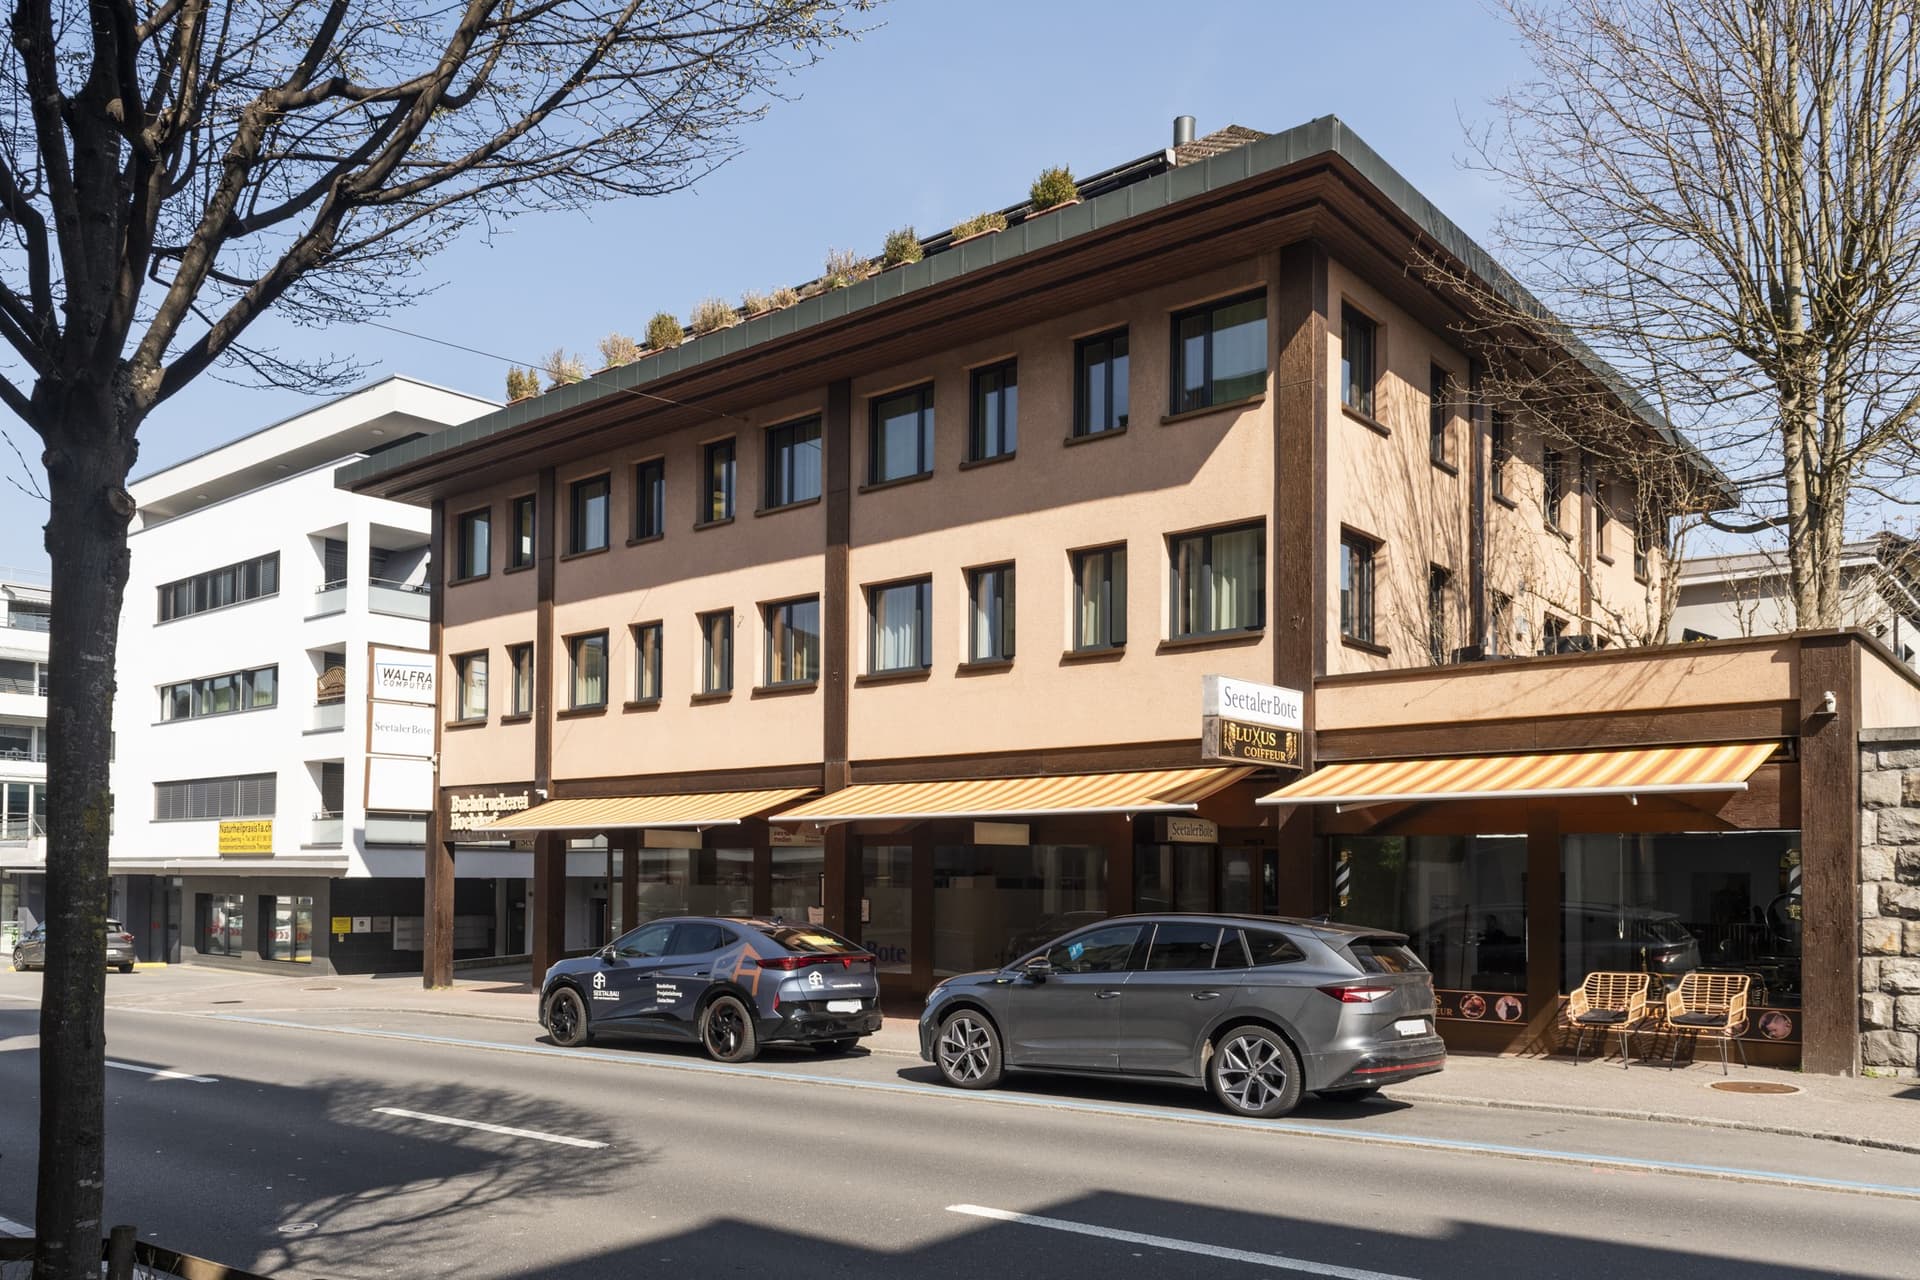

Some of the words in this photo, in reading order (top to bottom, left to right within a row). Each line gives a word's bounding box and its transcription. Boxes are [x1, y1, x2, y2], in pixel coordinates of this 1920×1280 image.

[383, 667, 433, 684] WALFRA
[383, 680, 433, 691] COMPUTER
[1236, 727, 1276, 747] LUXUS
[1244, 746, 1286, 761] COIFFEUR
[451, 790, 529, 812] Buchdruckerei
